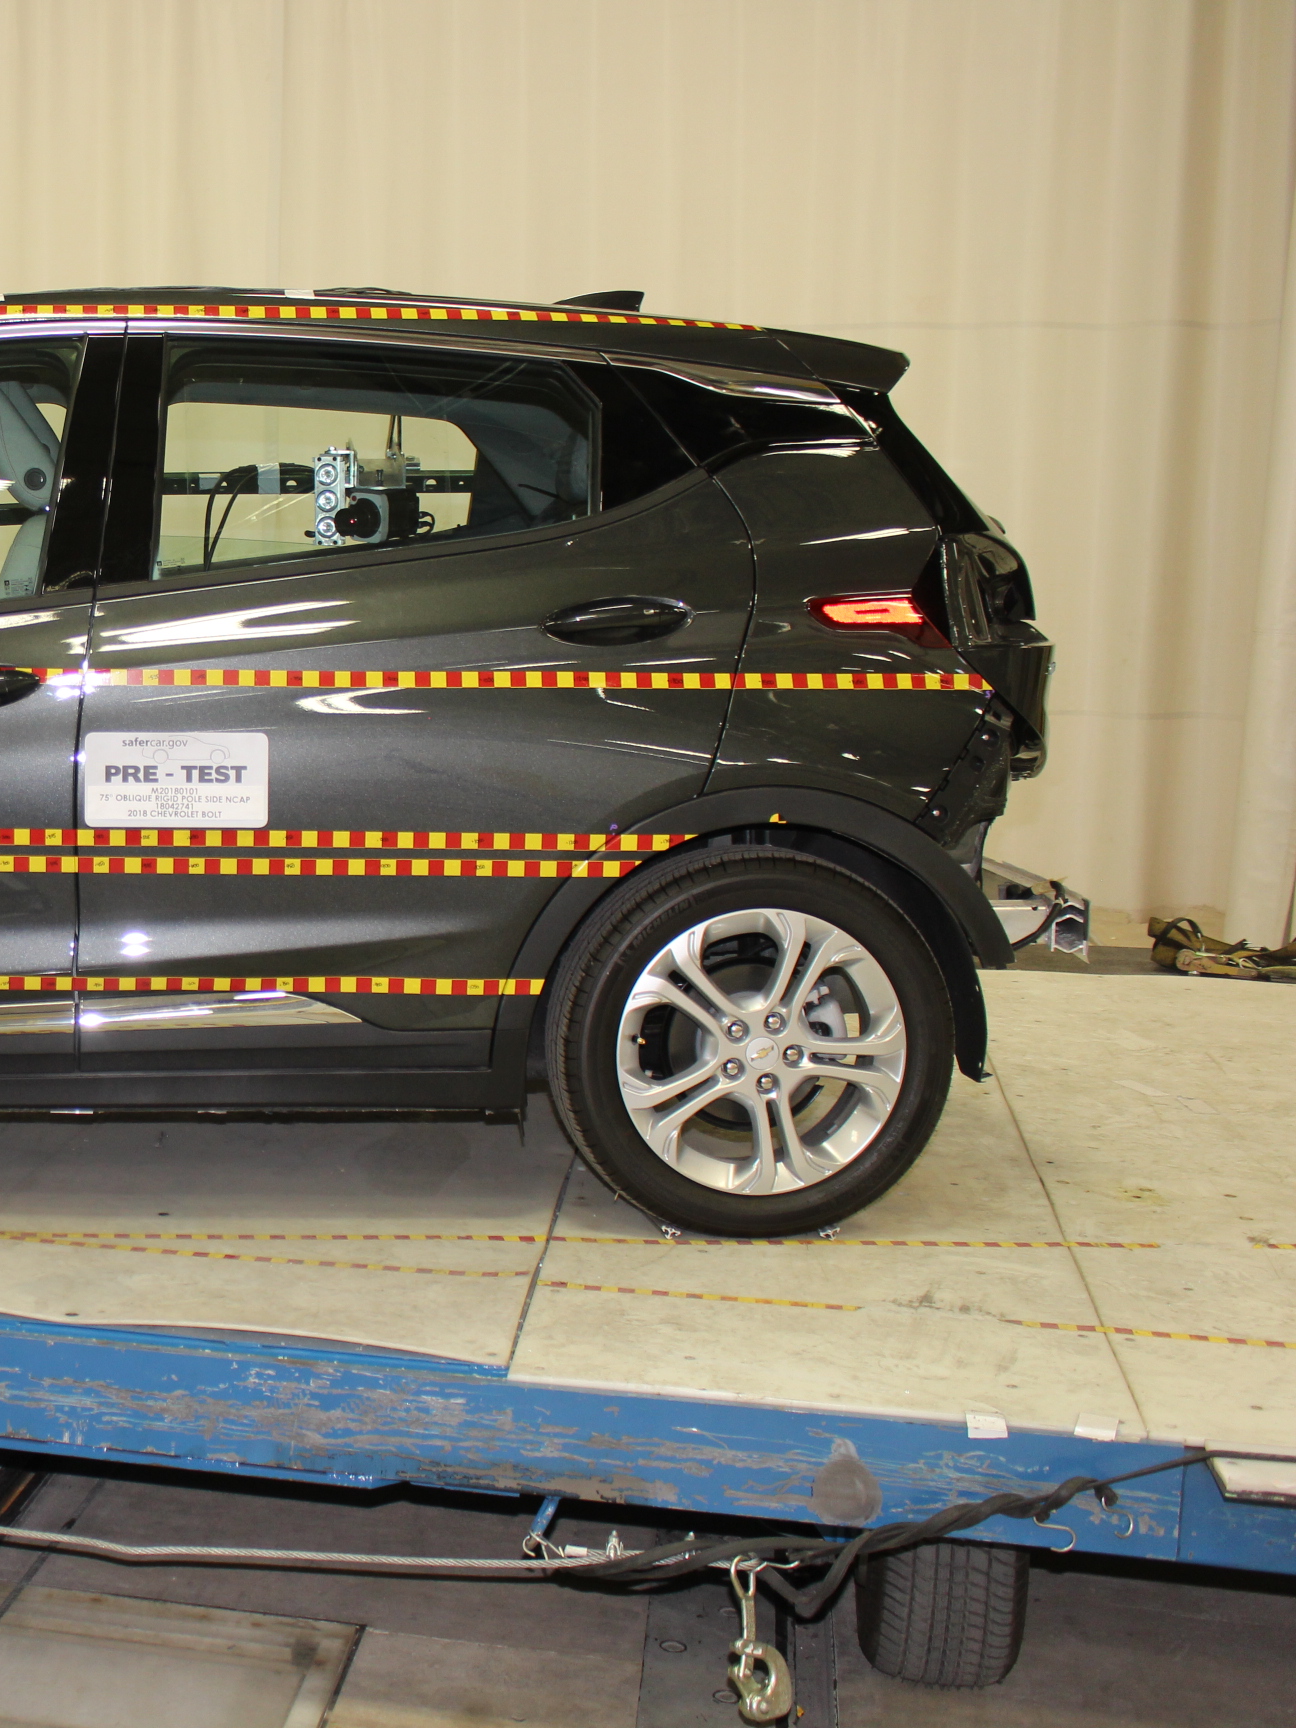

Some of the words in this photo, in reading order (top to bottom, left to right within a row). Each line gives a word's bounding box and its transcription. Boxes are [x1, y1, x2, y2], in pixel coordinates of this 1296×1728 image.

[121, 737, 189, 750] safercar.gov
[104, 765, 160, 783] PRE
[180, 765, 248, 784] TEST
[150, 787, 199, 796] M20180101
[115, 794, 153, 803] OBLIQUE
[155, 795, 179, 803] RIGID
[181, 795, 203, 803] POLE
[204, 796, 223, 804] SIDE
[225, 796, 251, 804] NCAP
[155, 802, 194, 811] 18042741
[127, 809, 148, 817] 2018
[150, 810, 200, 818] CHEVROLET
[201, 811, 223, 819] BOLT
